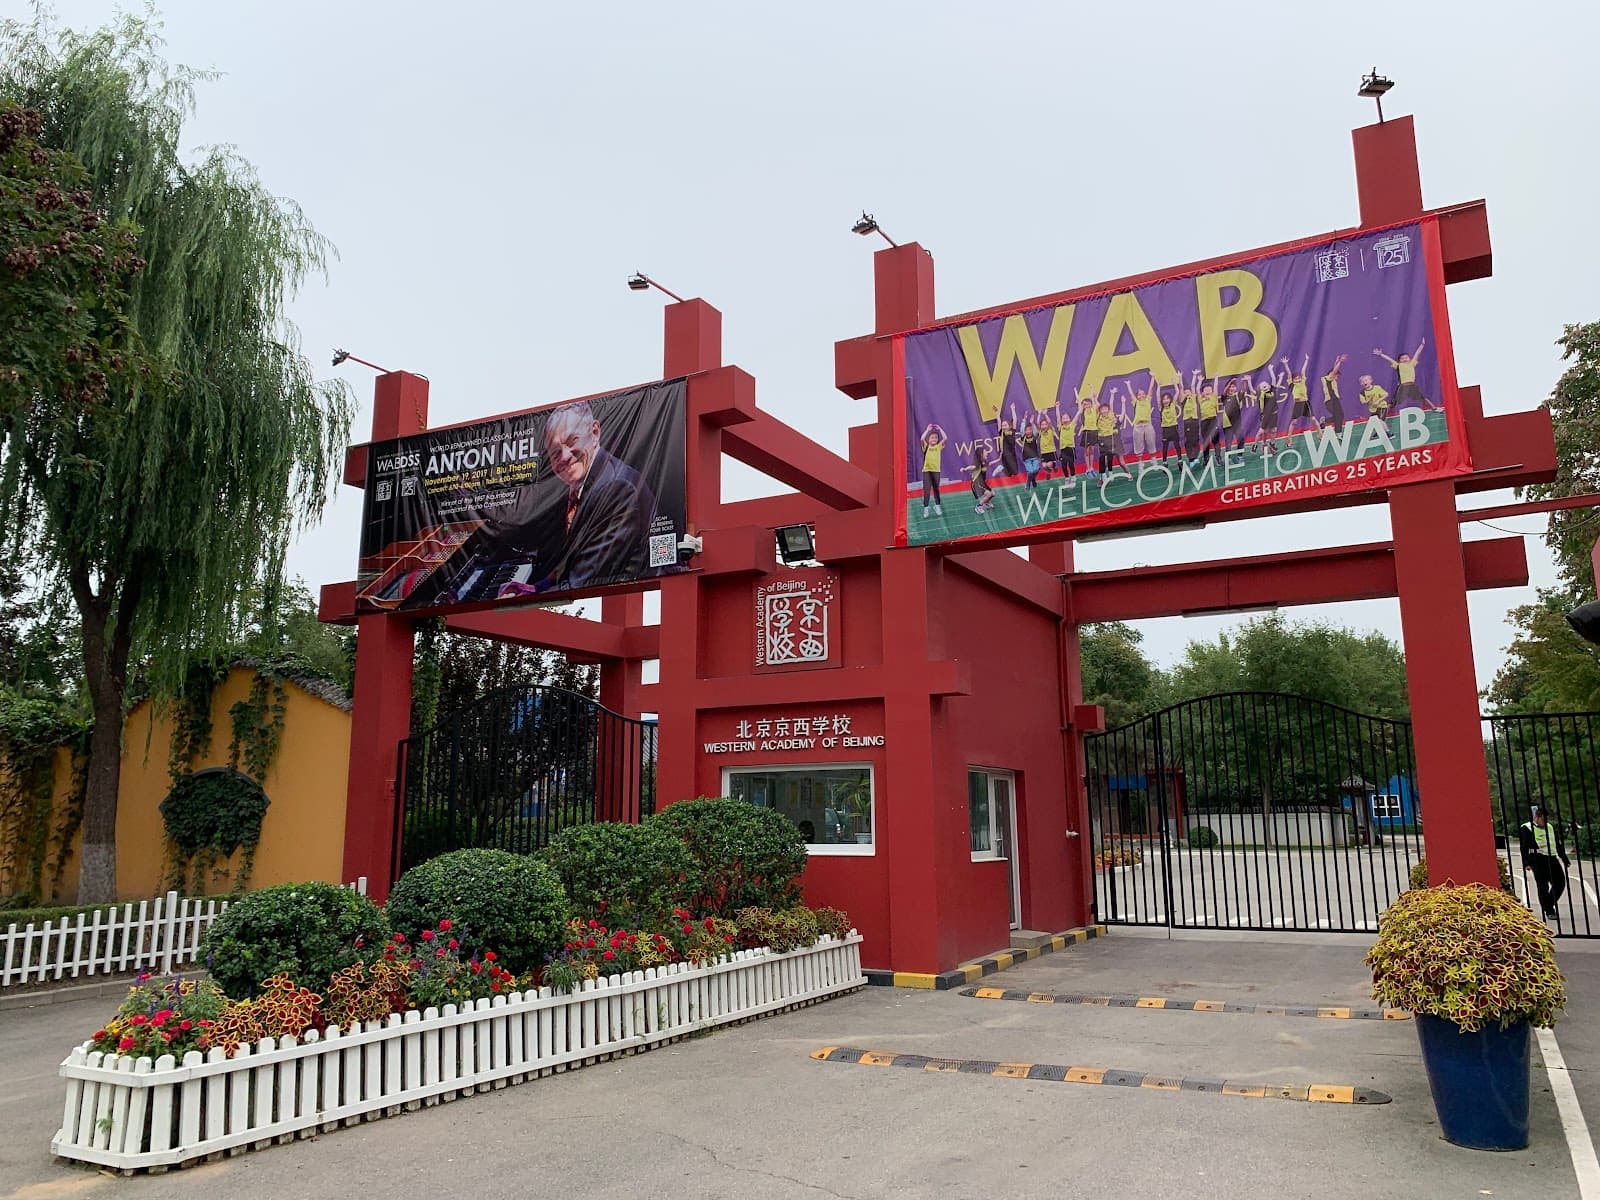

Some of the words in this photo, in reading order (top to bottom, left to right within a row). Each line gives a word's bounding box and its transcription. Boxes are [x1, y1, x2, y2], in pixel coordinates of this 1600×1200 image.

[957, 269, 1278, 422] WAB
[482, 432, 512, 444] CLASSICAL
[376, 453, 421, 472] WABDSS
[425, 444, 496, 476] ANTON
[502, 437, 539, 462] NEL
[1015, 448, 1246, 525] WELCOME
[1303, 406, 1432, 470] WAB
[424, 475, 459, 486] November
[472, 469, 488, 479] 2019
[509, 461, 537, 472] Theatre
[1220, 469, 1338, 504] CELEBRATING
[1346, 463, 1367, 480] 25
[1373, 449, 1432, 474] YEARS
[767, 582, 776, 592] of
[776, 580, 807, 592] Beijing
[755, 586, 766, 627] Academy
[756, 627, 765, 667] Western
[736, 714, 852, 739] 北京京西学校
[704, 740, 756, 754] WESTERN
[760, 738, 816, 751] ACADEMY
[822, 737, 839, 748] OF
[842, 735, 885, 748] BEIJING
